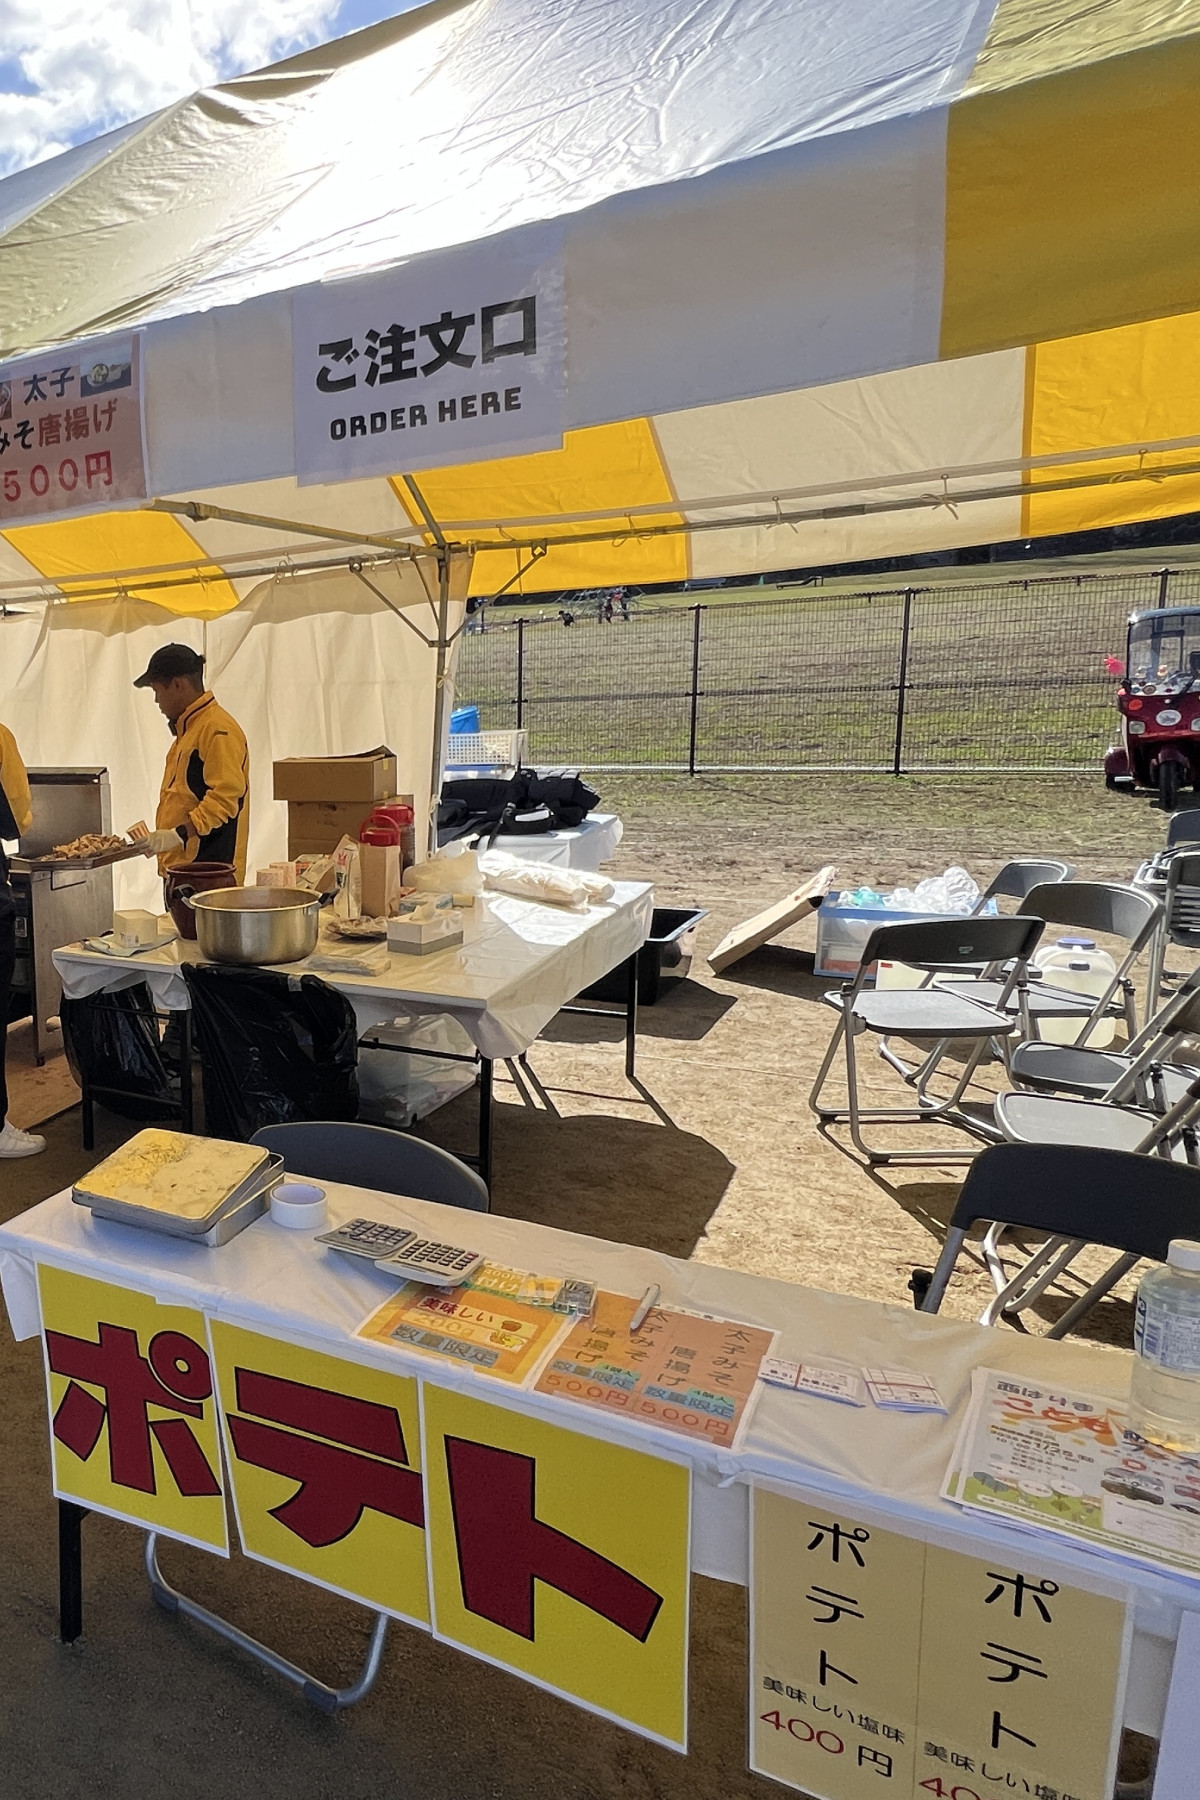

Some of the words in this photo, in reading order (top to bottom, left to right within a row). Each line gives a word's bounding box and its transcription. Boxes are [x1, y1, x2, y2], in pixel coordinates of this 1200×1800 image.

[315, 295, 537, 393] ご注文口
[23, 366, 75, 406] 太子
[330, 404, 428, 440] ORDER
[438, 386, 522, 422] HERE
[3, 450, 113, 502] 500円
[424, 1297, 494, 1324] 美味しい
[392, 1324, 498, 1367] 数量限定
[657, 1345, 697, 1386] 唐揚げ
[707, 1327, 754, 1387] 太子みそ
[545, 1374, 630, 1406] 500円
[640, 1401, 730, 1435] 500円
[45, 1321, 665, 1643] ポテト
[806, 1521, 871, 1687] ポテト
[979, 1571, 1060, 1749] ポテト
[762, 1676, 906, 1745] 美味しい塩味
[759, 1709, 893, 1778] 400円
[918, 1777, 1002, 1800] 40
